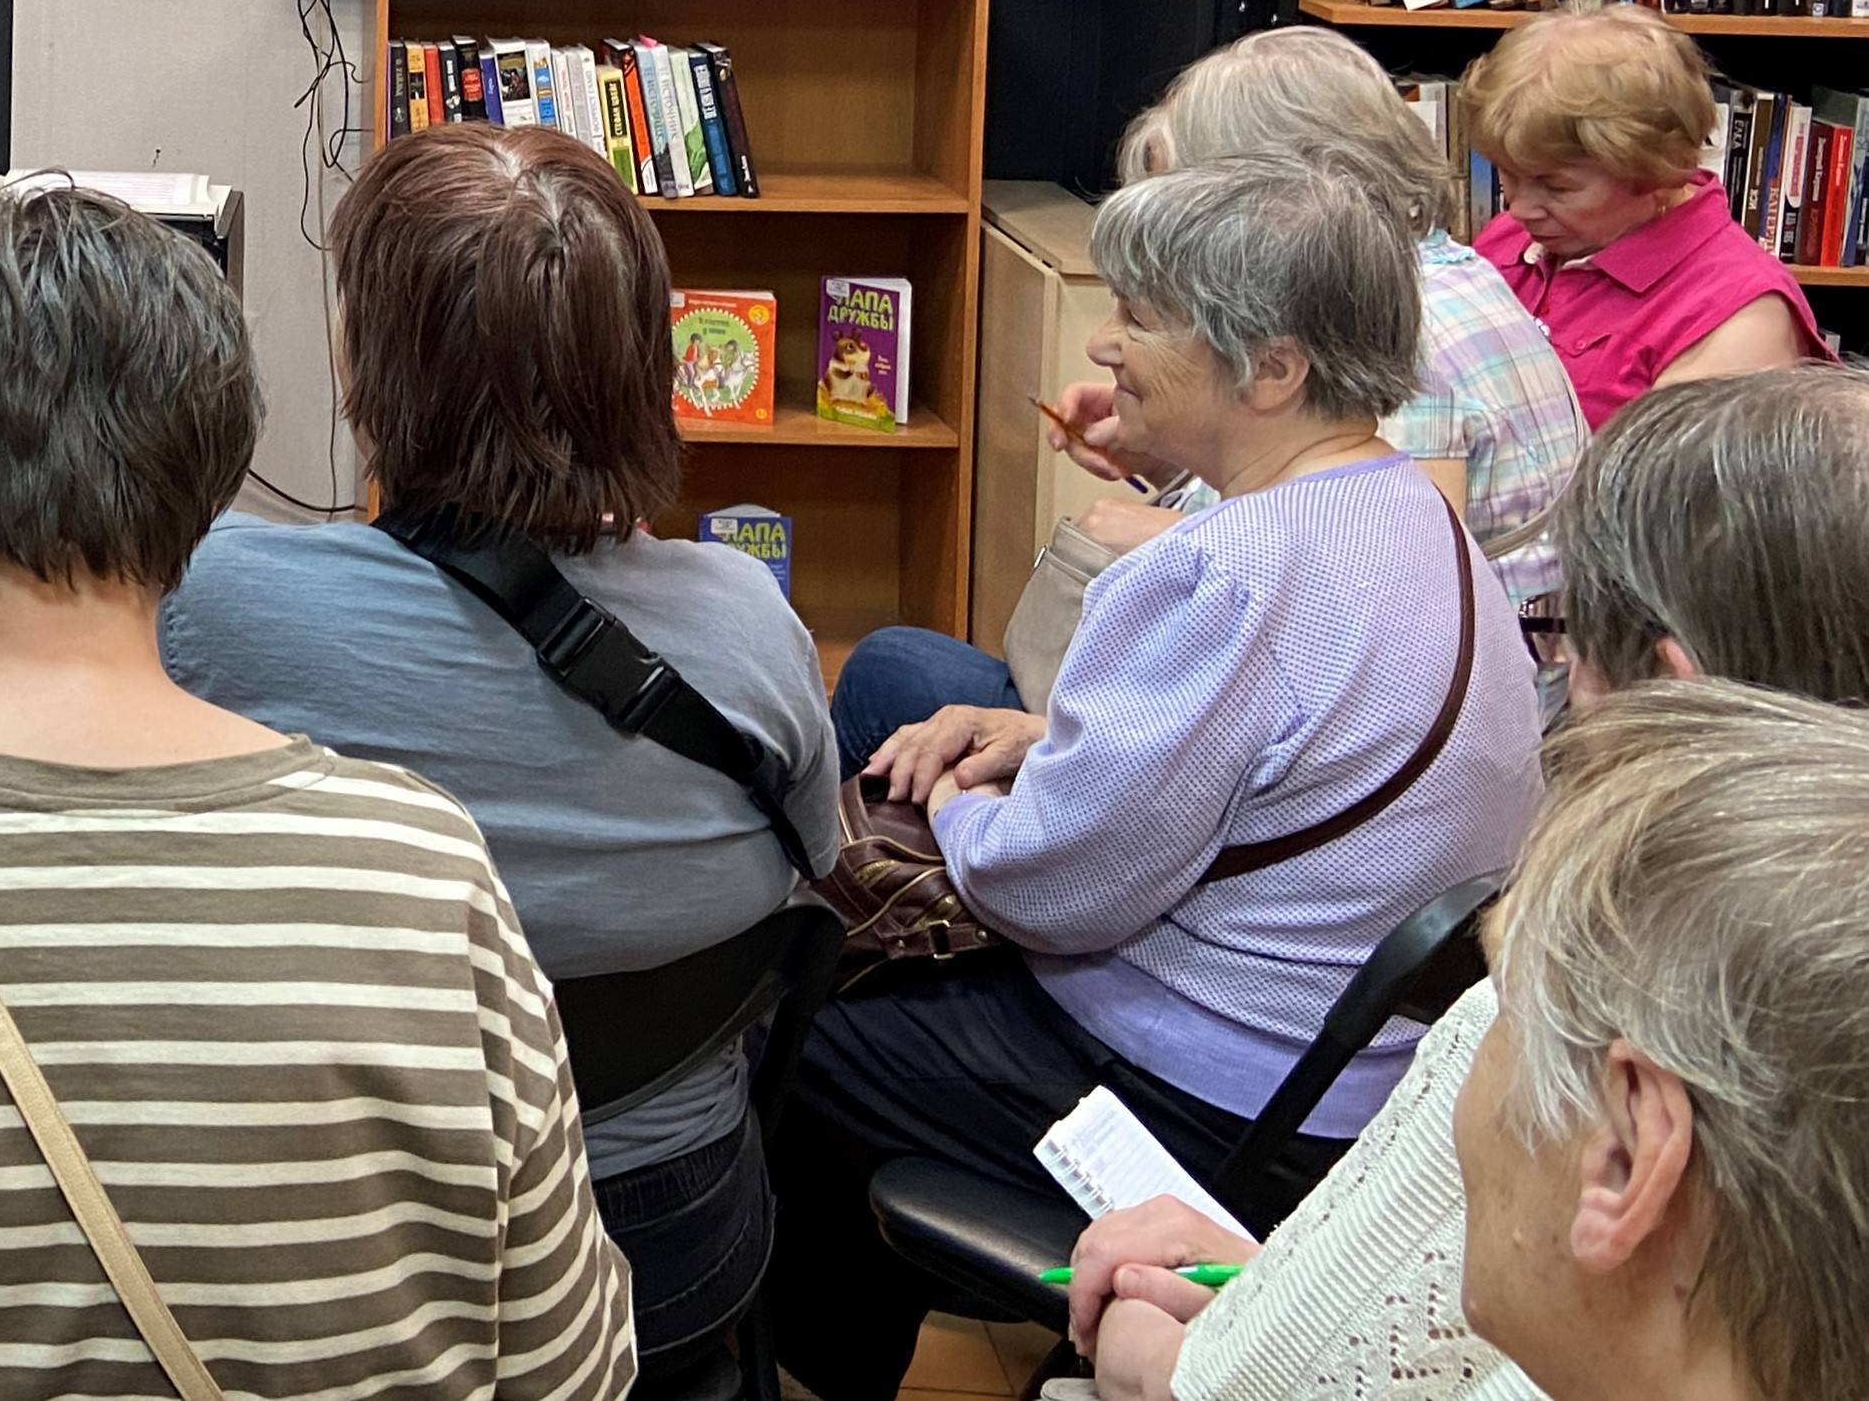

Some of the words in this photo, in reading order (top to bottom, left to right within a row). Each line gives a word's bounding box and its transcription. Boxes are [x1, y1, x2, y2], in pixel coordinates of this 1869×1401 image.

[612, 107, 623, 135] СТЕФАН
[647, 80, 664, 141] ИСТОЧНИК
[662, 80, 678, 140] ИСТОЧНИК
[828, 305, 894, 330] ДРУЖБЫ
